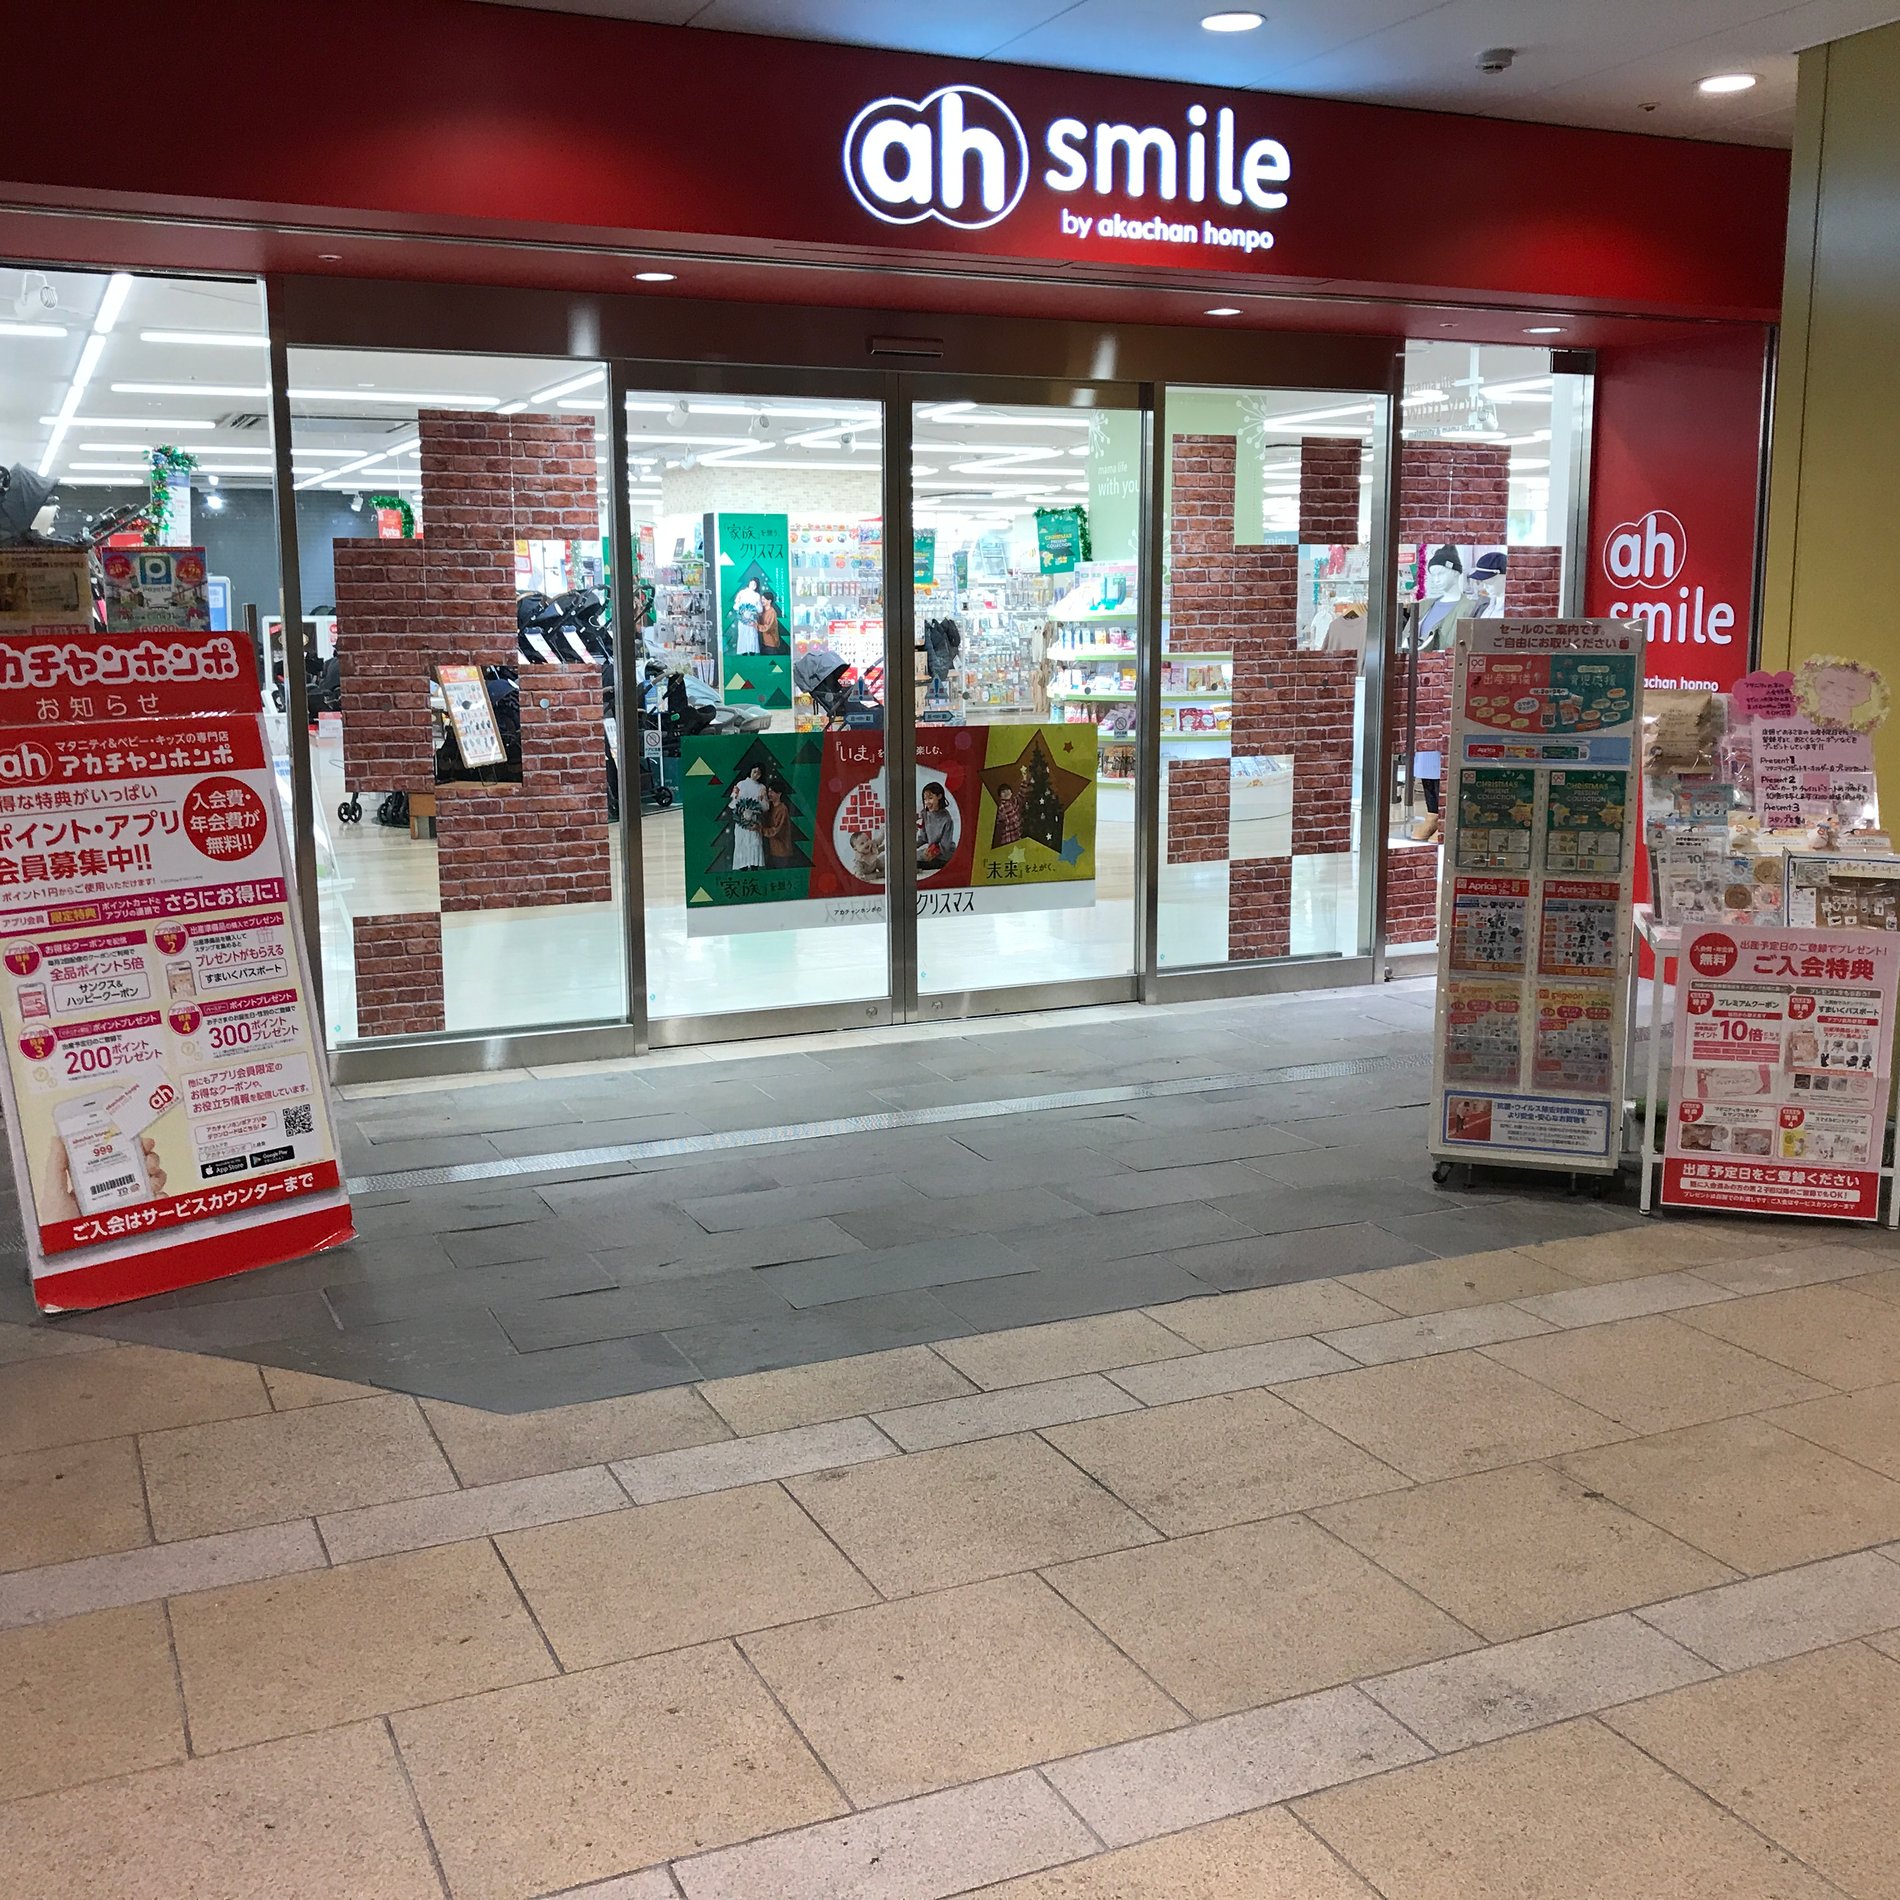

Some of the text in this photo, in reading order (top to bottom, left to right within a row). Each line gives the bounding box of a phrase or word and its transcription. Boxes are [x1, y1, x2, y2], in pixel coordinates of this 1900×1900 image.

[861, 91, 1005, 212] ah
[1044, 104, 1291, 210] smile
[1061, 208, 1274, 254] by akachan honpo
[1098, 476, 1120, 496] with
[740, 543, 784, 559] クリスマス
[1610, 514, 1675, 578] ah
[1500, 624, 1605, 635] セールのご案内です。
[1493, 637, 1617, 649] ご自由にお取りください
[1483, 673, 1531, 685] 出産準備
[36, 693, 160, 720] お知らせ
[0, 744, 46, 777] ah
[57, 743, 235, 777] アカチャンホンポ
[0, 810, 180, 851] ポイント・アプリ
[190, 810, 261, 833] 年会費が
[1687, 855, 1702, 864] 10
[1468, 882, 1497, 891] Aprica
[1558, 885, 1586, 895] Aprica
[102, 896, 161, 911] ポイントカードと
[164, 881, 281, 912] さらにお得に!
[917, 891, 974, 916] クリスマス
[50, 906, 97, 923] 限定特典
[834, 906, 882, 916] アカチャンホンポの
[2, 915, 45, 928] アプリ会員
[168, 942, 176, 952] 2
[195, 944, 284, 968] プレゼントがもらえる
[1740, 940, 1887, 956] 出産予定日のご登録でプレゼント!
[1700, 953, 1726, 966] 無料
[1753, 955, 1874, 981] ご入会特典
[50, 957, 145, 982] 全品ポイント5倍
[205, 964, 283, 984] すまいくパスポート
[67, 987, 139, 1007] ハッピークーポン
[230, 993, 292, 1010] ポイントプレゼント
[1551, 991, 1583, 1000] pigeon
[1719, 999, 1779, 1008] プレミアムクーポン
[1818, 1005, 1879, 1016] すまいくパスポート
[93, 1014, 157, 1031] ポイントプレゼント
[251, 1017, 287, 1030] ポイント
[1720, 1020, 1763, 1042] 10倍
[209, 1022, 251, 1048] 300
[253, 1026, 299, 1041] プレゼント
[112, 1040, 149, 1054] ポイント
[64, 1046, 112, 1075] 200
[113, 1048, 163, 1066] プレゼント
[188, 1063, 283, 1088] 他にもアプリ会員限定の
[149, 1085, 174, 1109] ah
[191, 1081, 262, 1100] お得なクーポンや、
[93, 1144, 113, 1157] 999
[216, 1165, 228, 1174] App
[228, 1163, 244, 1172] Store
[1682, 1163, 1860, 1187] 出産予定日をご登録ください
[72, 1172, 314, 1241] ご入会はサービスカウンターまで
